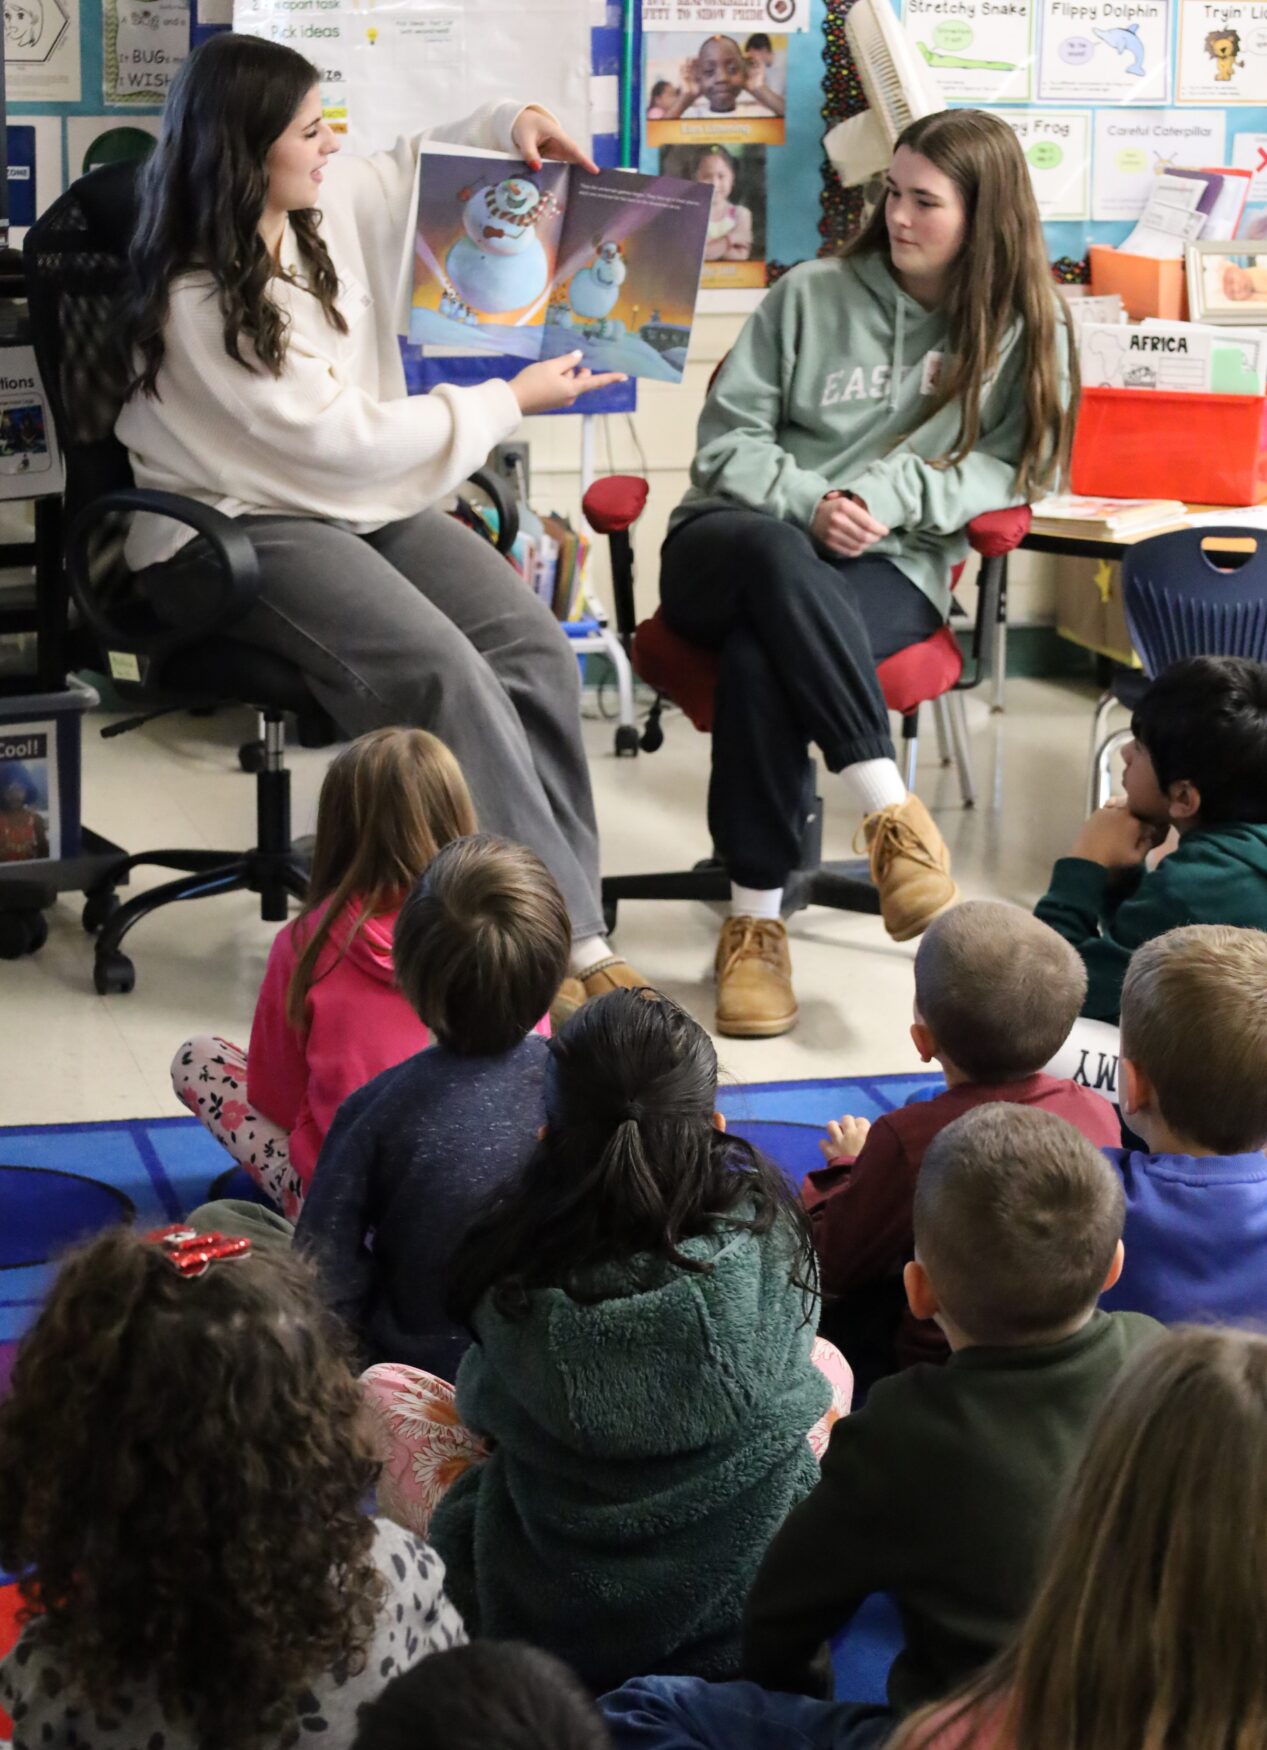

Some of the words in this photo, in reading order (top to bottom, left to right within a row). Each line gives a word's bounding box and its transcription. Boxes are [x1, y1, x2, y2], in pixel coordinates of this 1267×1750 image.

[908, 0, 975, 18] Stretchy
[981, 2, 1027, 16] Snake
[1051, 2, 1097, 20] Flippy
[1103, 3, 1158, 20] Dolphin
[300, 23, 340, 38] ideas
[1033, 119, 1070, 138] Frog
[1107, 125, 1149, 137] Careful
[1152, 126, 1212, 138] Caterpillar
[1129, 334, 1189, 353] AFRICA
[820, 364, 913, 407] EAS
